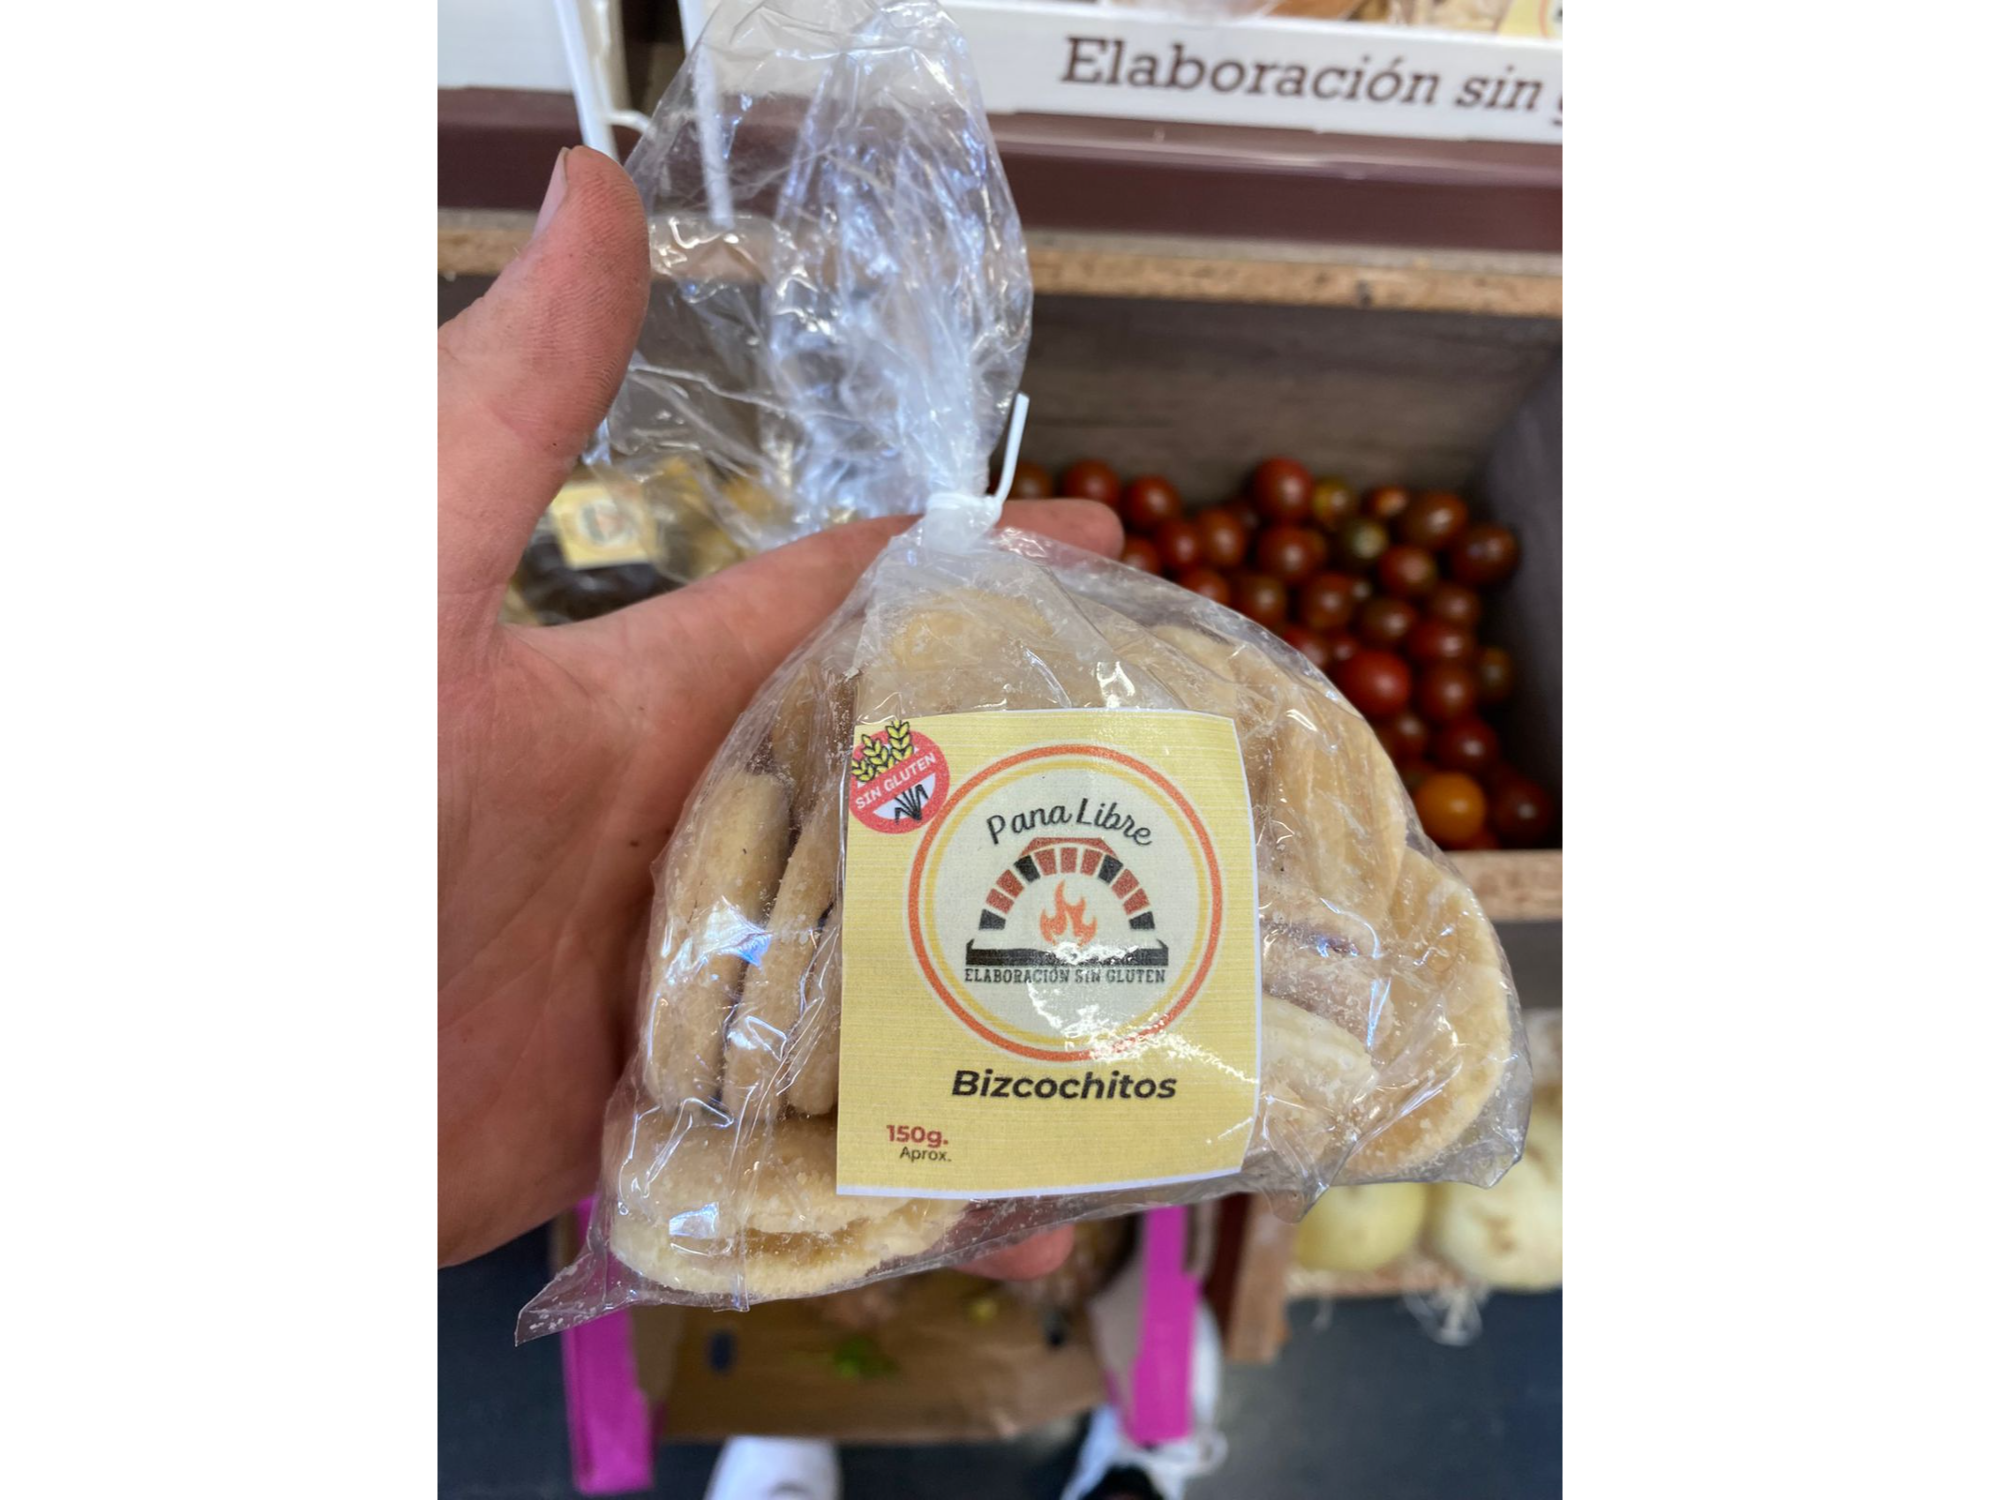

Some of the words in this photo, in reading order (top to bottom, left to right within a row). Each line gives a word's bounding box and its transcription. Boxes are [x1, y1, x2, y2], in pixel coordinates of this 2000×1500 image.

[1060, 36, 1440, 105] Elaboración
[1456, 65, 1544, 113] sin
[855, 784, 883, 810] SIN
[884, 751, 937, 790] GLUTEN
[986, 804, 1072, 846] Pana
[1074, 797, 1153, 847] Libre
[964, 966, 1070, 985] ELABORACIÓN
[1073, 968, 1102, 985] SIN
[1105, 968, 1167, 985] GLUTEN
[952, 1069, 1178, 1100] Bizcochitos
[886, 1124, 949, 1149] 150g.
[899, 1146, 952, 1163] Aprox.
